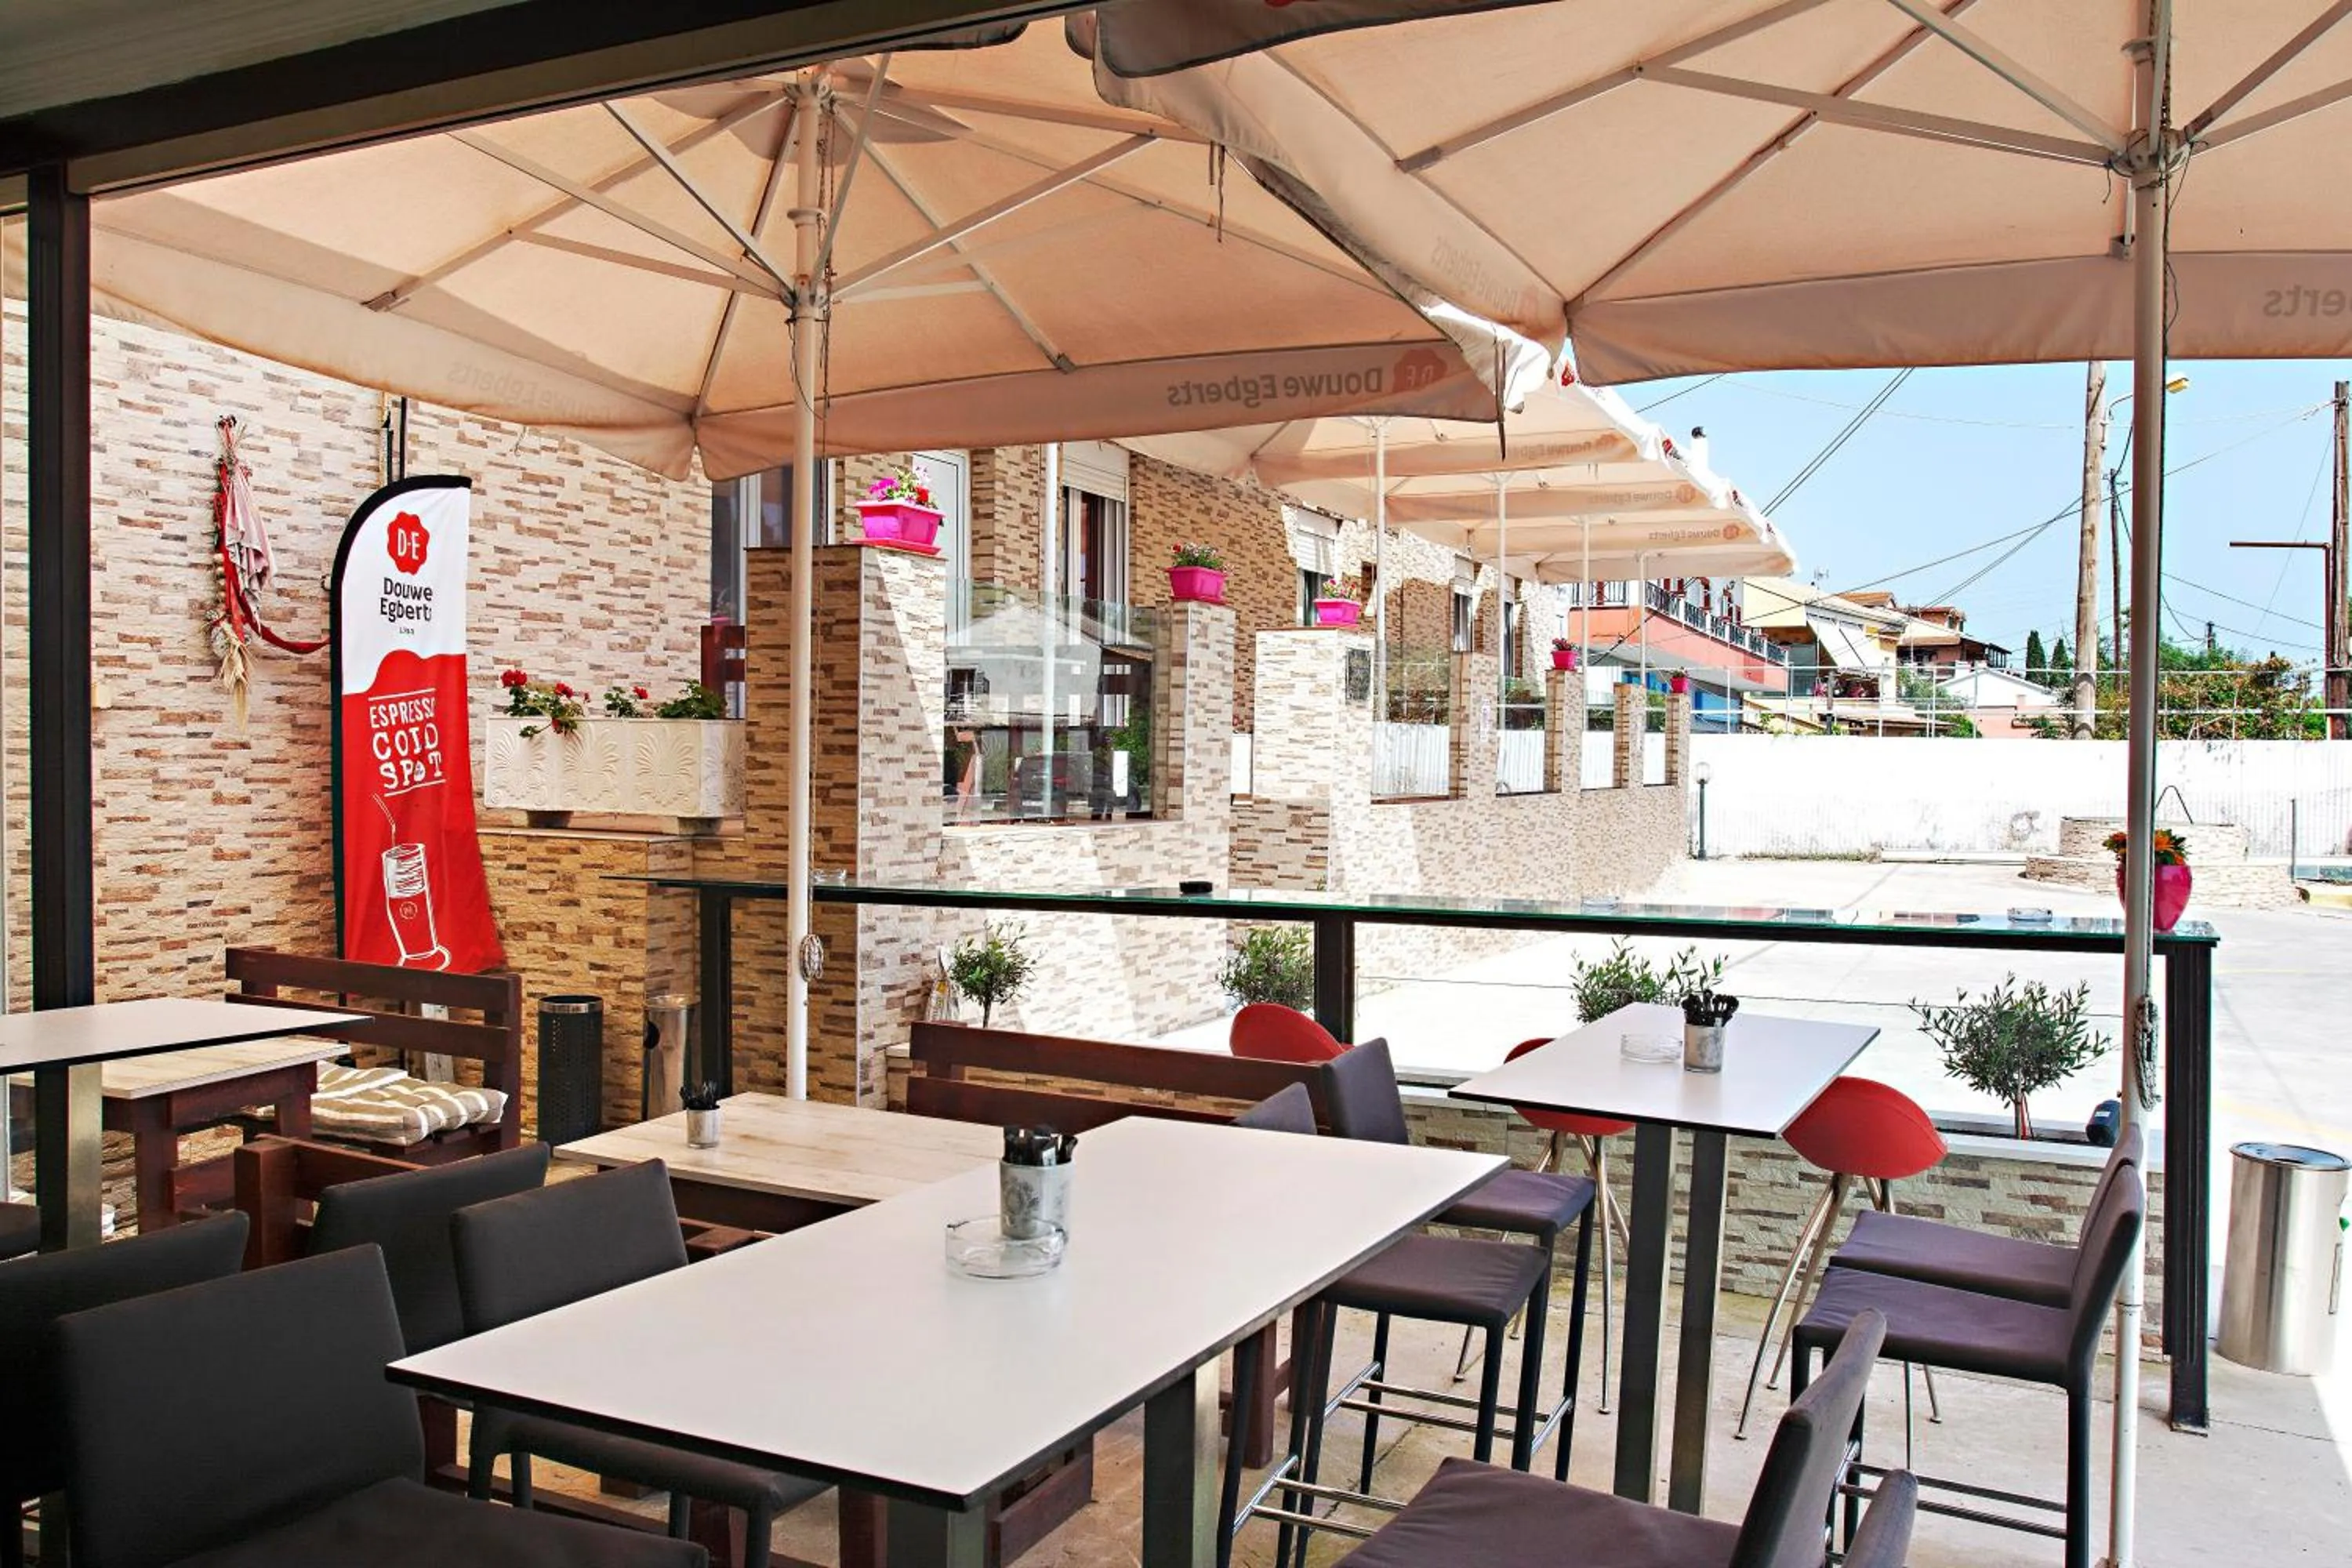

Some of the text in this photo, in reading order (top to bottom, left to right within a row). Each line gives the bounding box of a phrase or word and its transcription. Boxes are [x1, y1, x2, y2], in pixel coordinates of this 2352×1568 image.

[383, 576, 434, 601] Douwe
[379, 597, 432, 623] Egbert
[369, 696, 436, 728] ESPRESS
